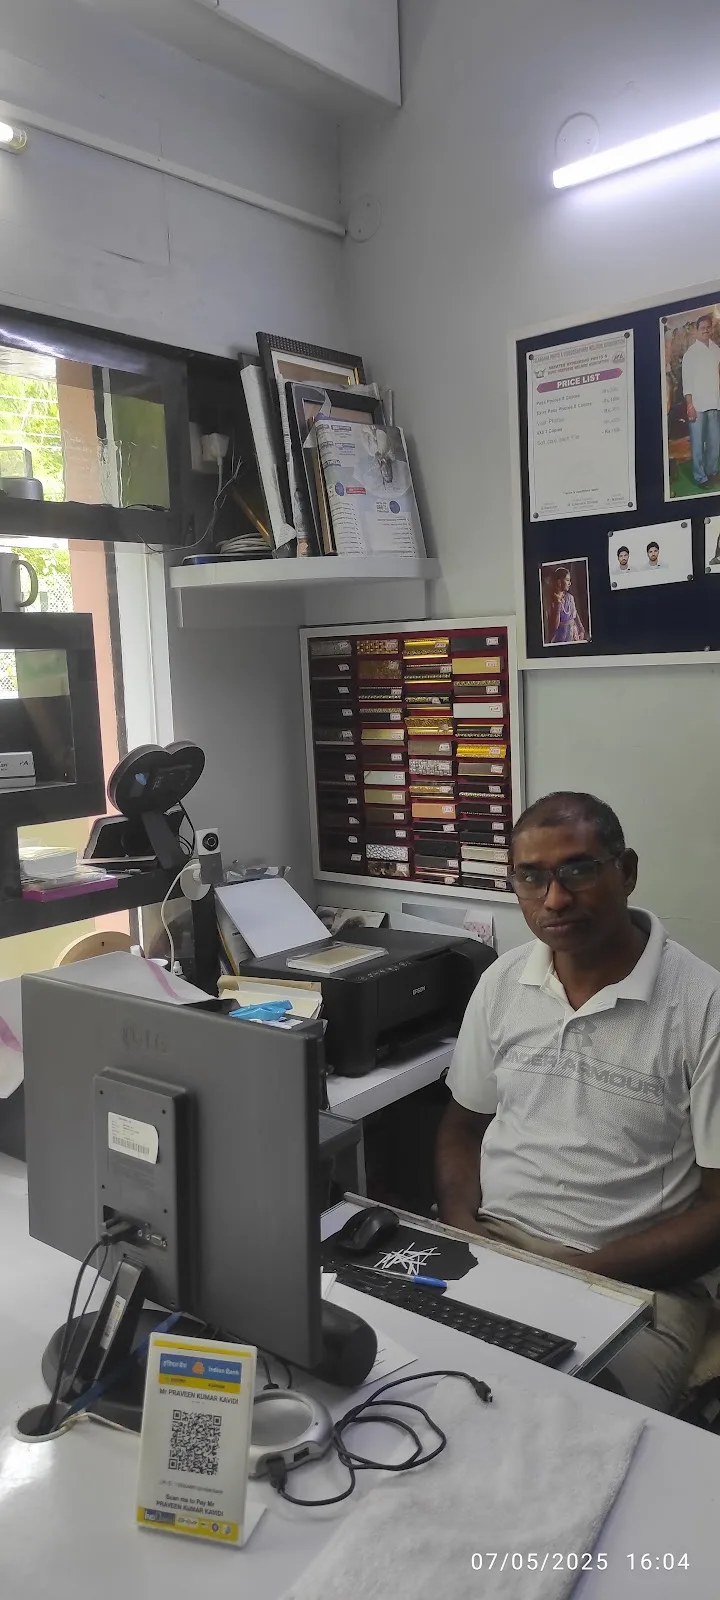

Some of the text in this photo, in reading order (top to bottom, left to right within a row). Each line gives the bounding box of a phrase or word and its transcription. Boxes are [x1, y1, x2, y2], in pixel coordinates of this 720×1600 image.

[557, 373, 601, 389] PRICE LIST
[562, 1057, 662, 1098] ARMOUR
[208, 1365, 239, 1375] Indian Bank
[168, 1389, 195, 1398] PRAVEEN
[196, 1392, 218, 1401] KUMAR
[219, 1396, 239, 1404] KAVIDI
[156, 1500, 182, 1510] PRAVEEN
[183, 1505, 204, 1513] KUMAR
[196, 1499, 206, 1507] Pay
